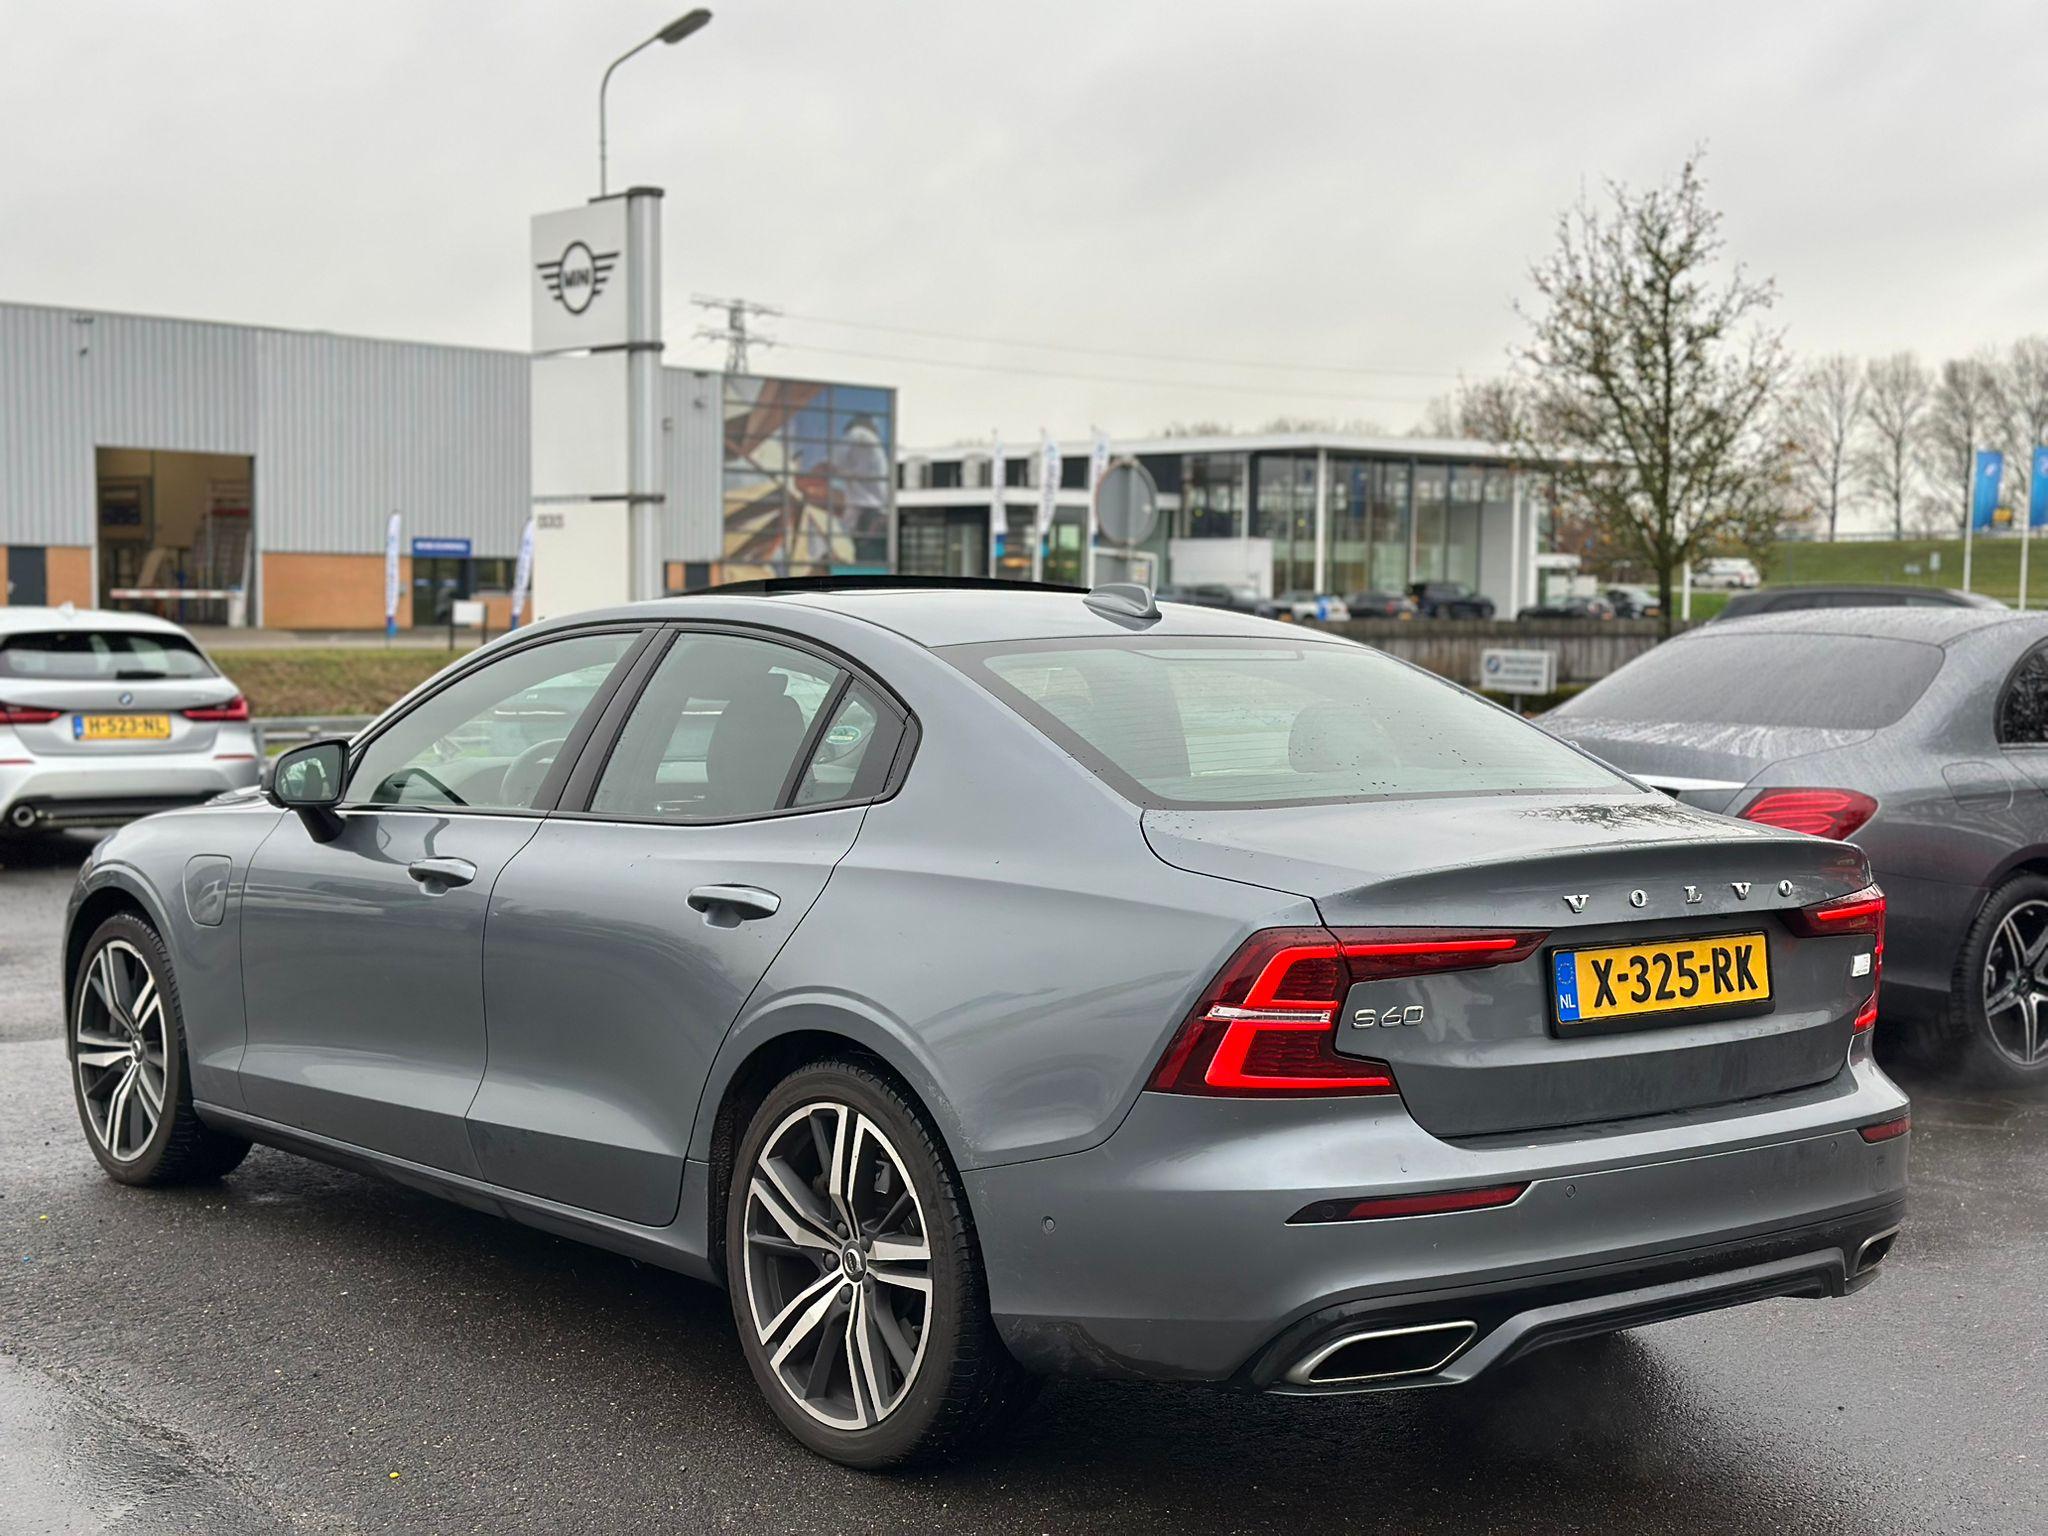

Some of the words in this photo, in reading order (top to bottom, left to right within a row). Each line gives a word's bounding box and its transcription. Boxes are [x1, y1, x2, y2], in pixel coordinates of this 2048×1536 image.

[565, 269, 590, 287] MINI
[88, 718, 165, 733] H-523-NL
[1563, 879, 1794, 914] VOLVO
[1591, 944, 1759, 1008] X-325-RK
[1559, 993, 1576, 1009] NL
[1352, 1005, 1424, 1029] S60
